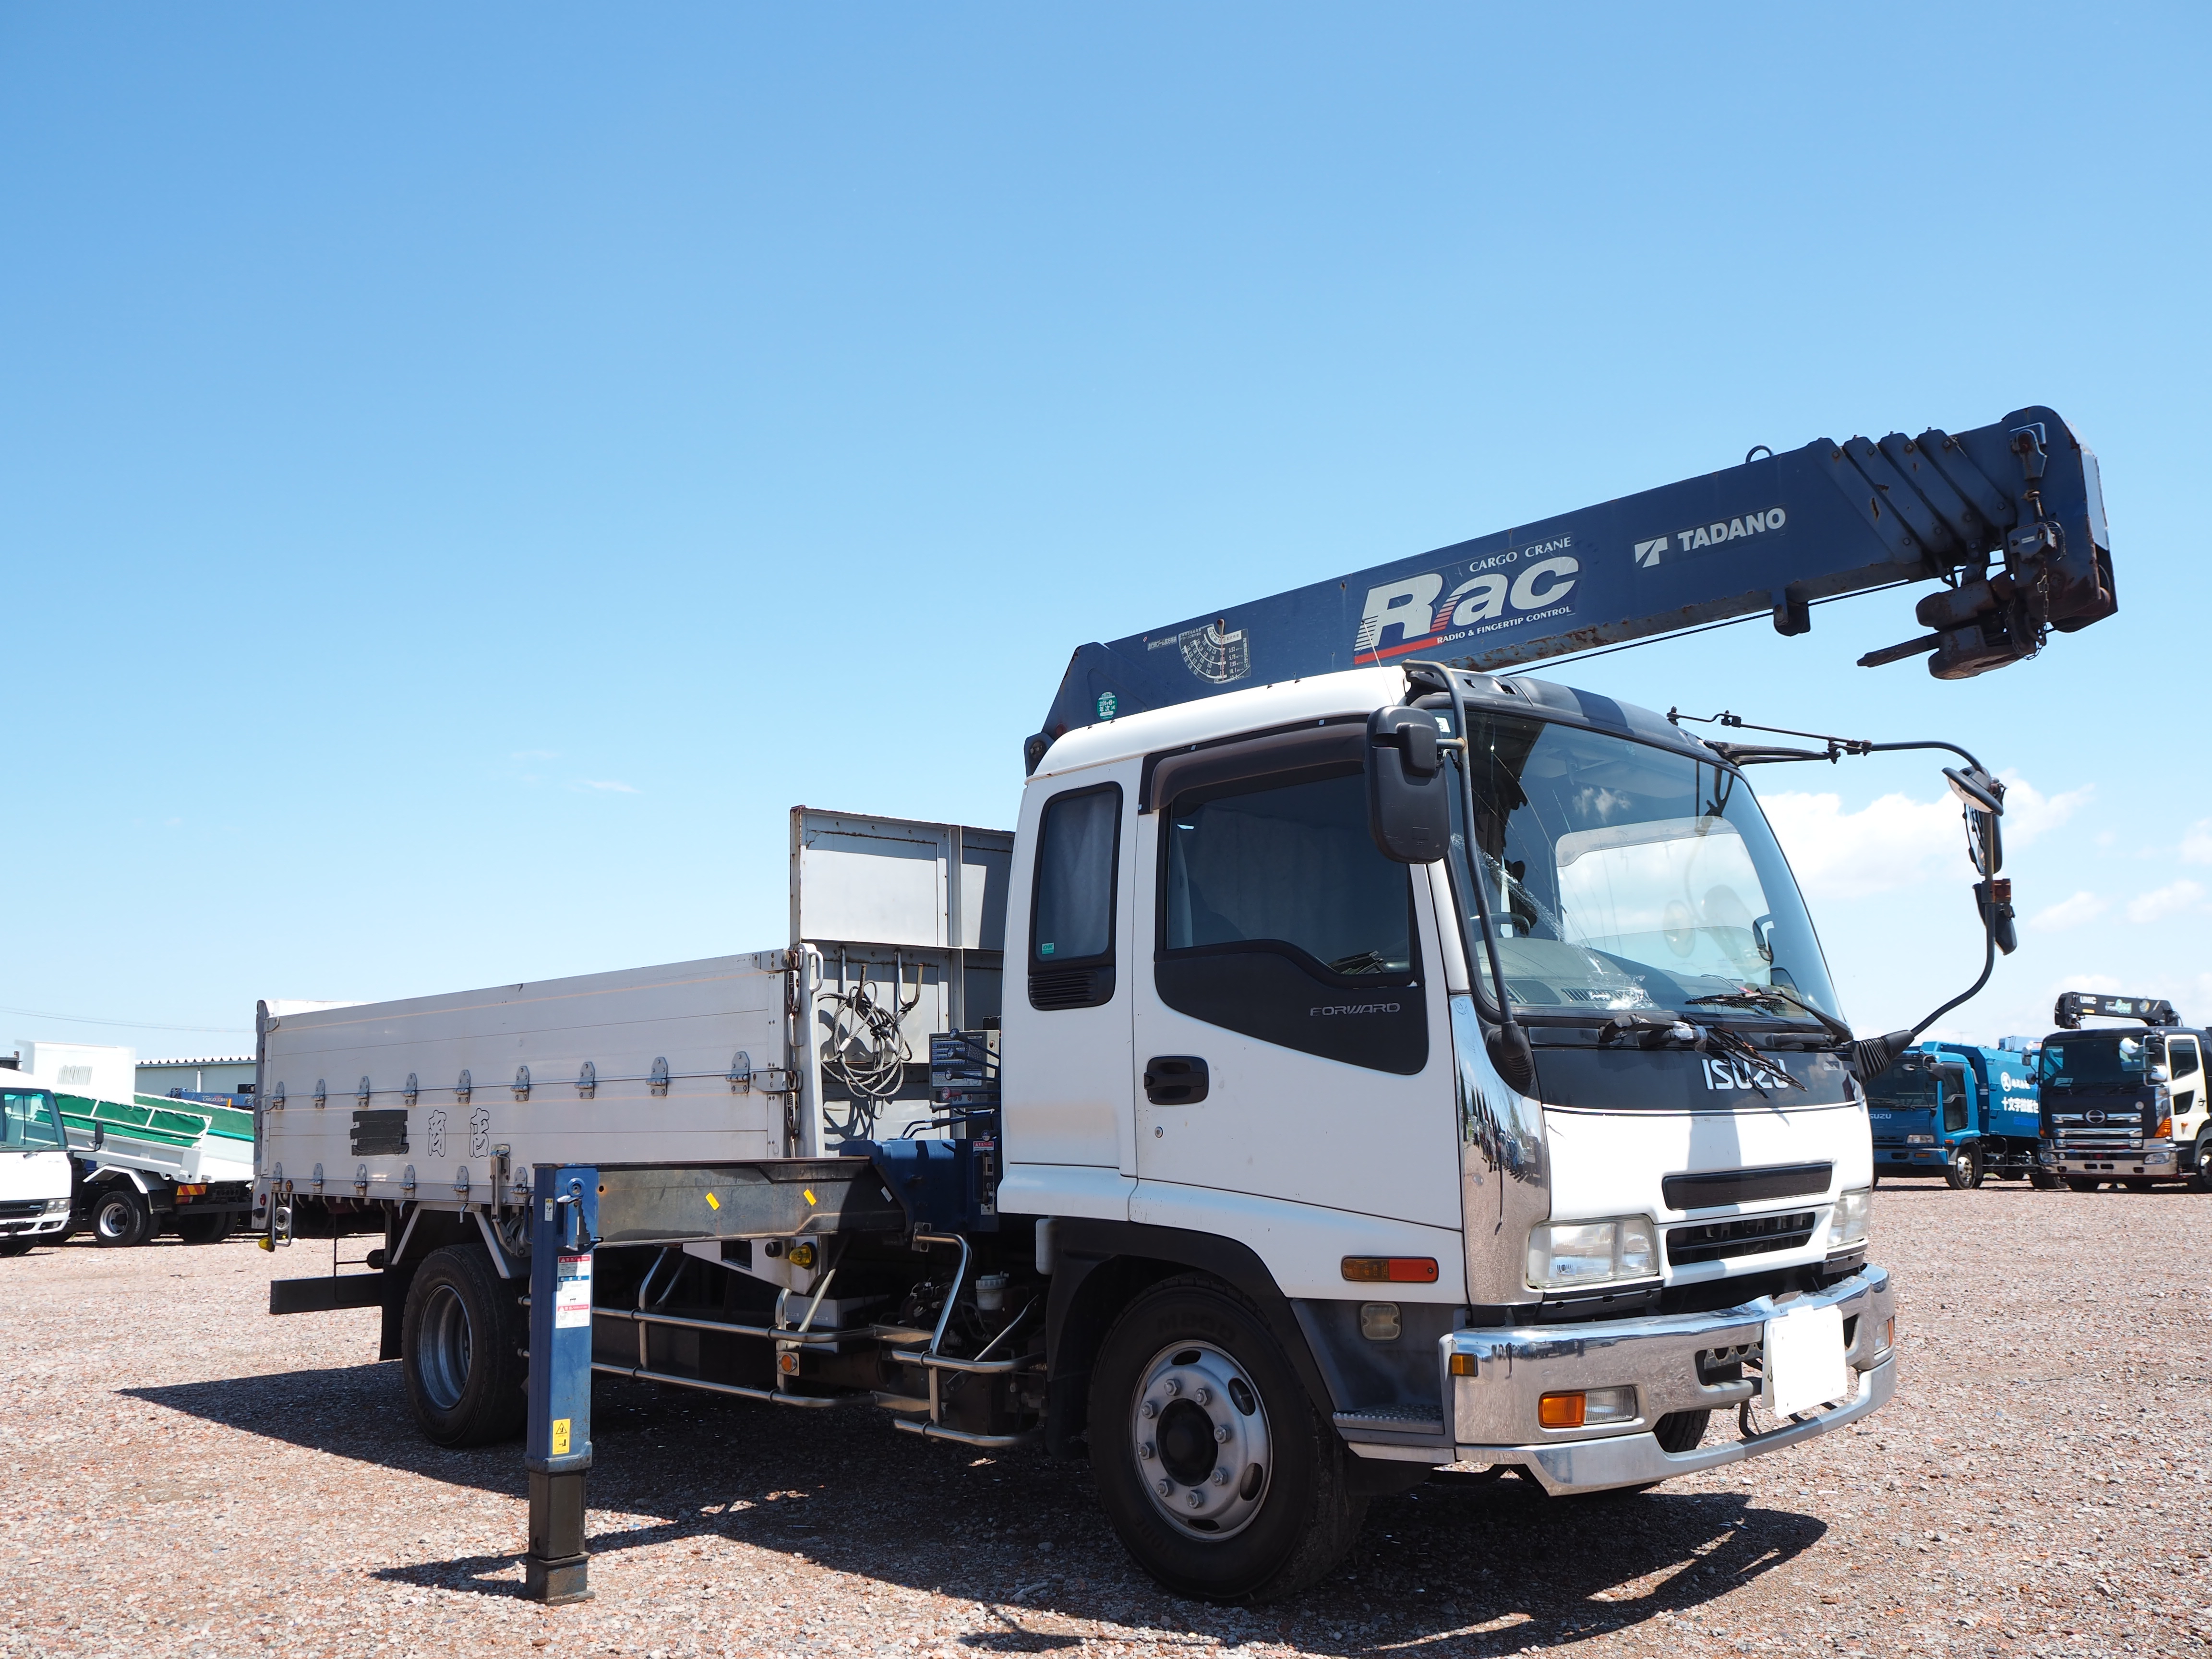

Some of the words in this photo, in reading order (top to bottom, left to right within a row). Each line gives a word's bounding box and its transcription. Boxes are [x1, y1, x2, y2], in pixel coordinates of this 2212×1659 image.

[1677, 508, 1786, 552] TADANO
[1469, 551, 1517, 572] CARGO
[1525, 537, 1572, 558] CRANE
[1354, 556, 1579, 651] Rac
[1437, 631, 1466, 644] RADIO
[1477, 617, 1524, 634] FINGERTIP
[1526, 606, 1572, 622] CONTROL
[1310, 1002, 1401, 1016] FORWARD
[1701, 1058, 1789, 1090] ISUZU
